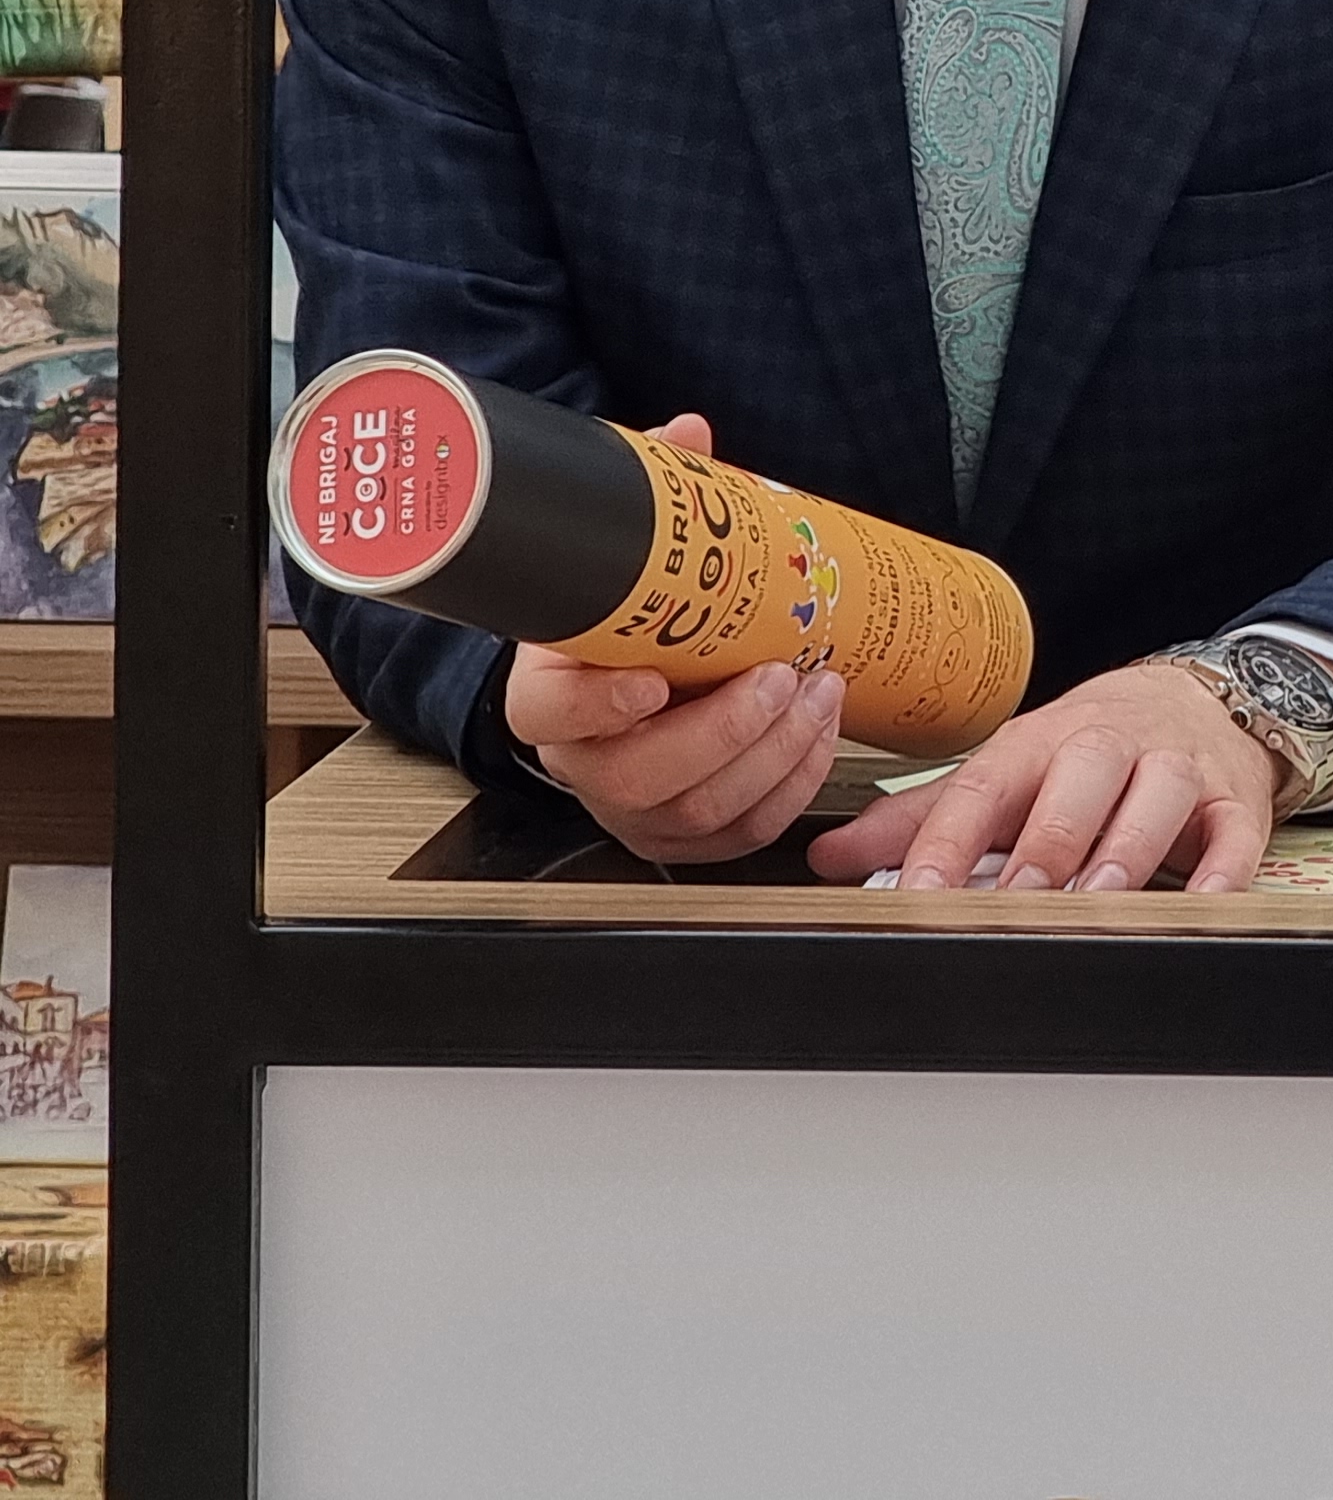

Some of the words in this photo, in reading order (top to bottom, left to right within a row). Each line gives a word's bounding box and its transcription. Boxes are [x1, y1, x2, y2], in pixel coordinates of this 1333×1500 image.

[318, 415, 339, 505] BRIGAJ
[400, 408, 417, 469] GORA
[318, 510, 336, 545] NE
[400, 476, 417, 535] CRNA
[613, 588, 670, 638] NE
[698, 568, 761, 658] CRNA
